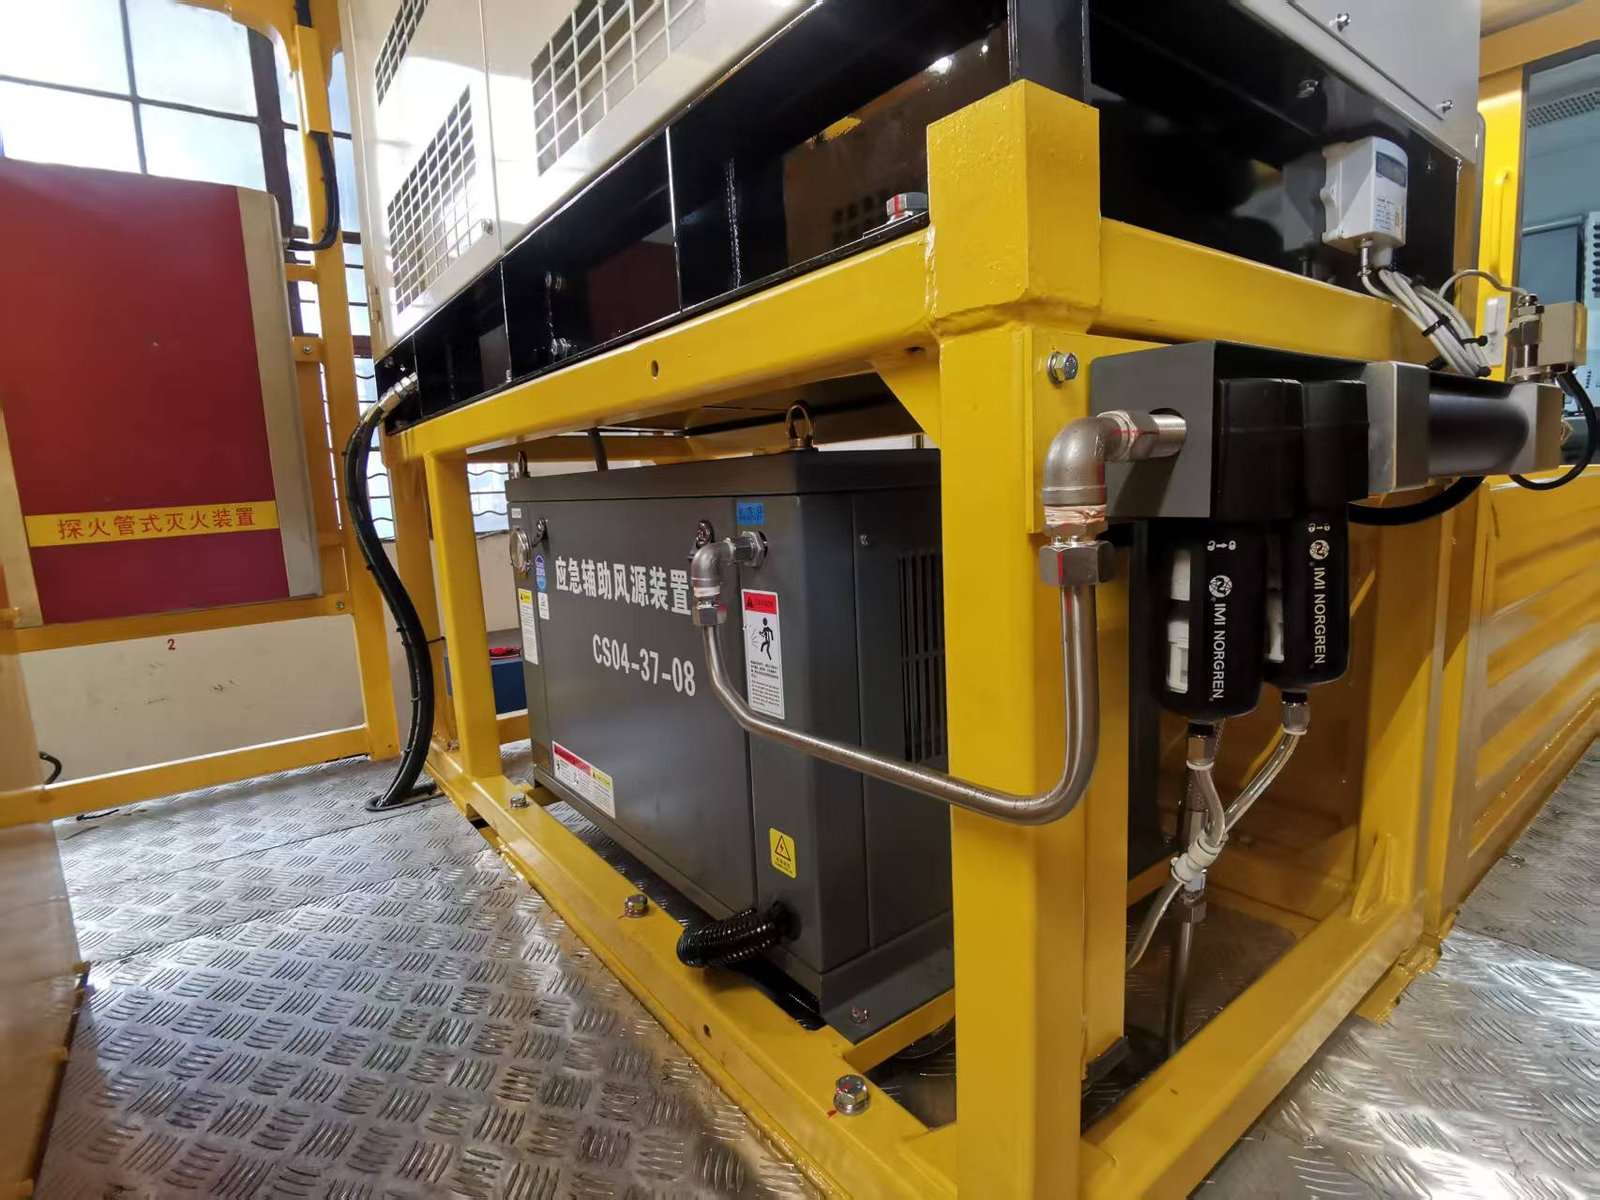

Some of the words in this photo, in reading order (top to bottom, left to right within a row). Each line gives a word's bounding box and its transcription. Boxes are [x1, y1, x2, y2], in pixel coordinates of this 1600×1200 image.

[58, 507, 255, 539] 探火管式灭火装置
[555, 556, 691, 615] 应急辅助风源装置
[1314, 567, 1326, 589] IMI
[1214, 603, 1226, 625] IMI
[1314, 594, 1326, 664] NORGREN
[167, 639, 175, 650] 2
[593, 634, 695, 696] CS04-37-08
[1213, 630, 1226, 698] NORGREN
